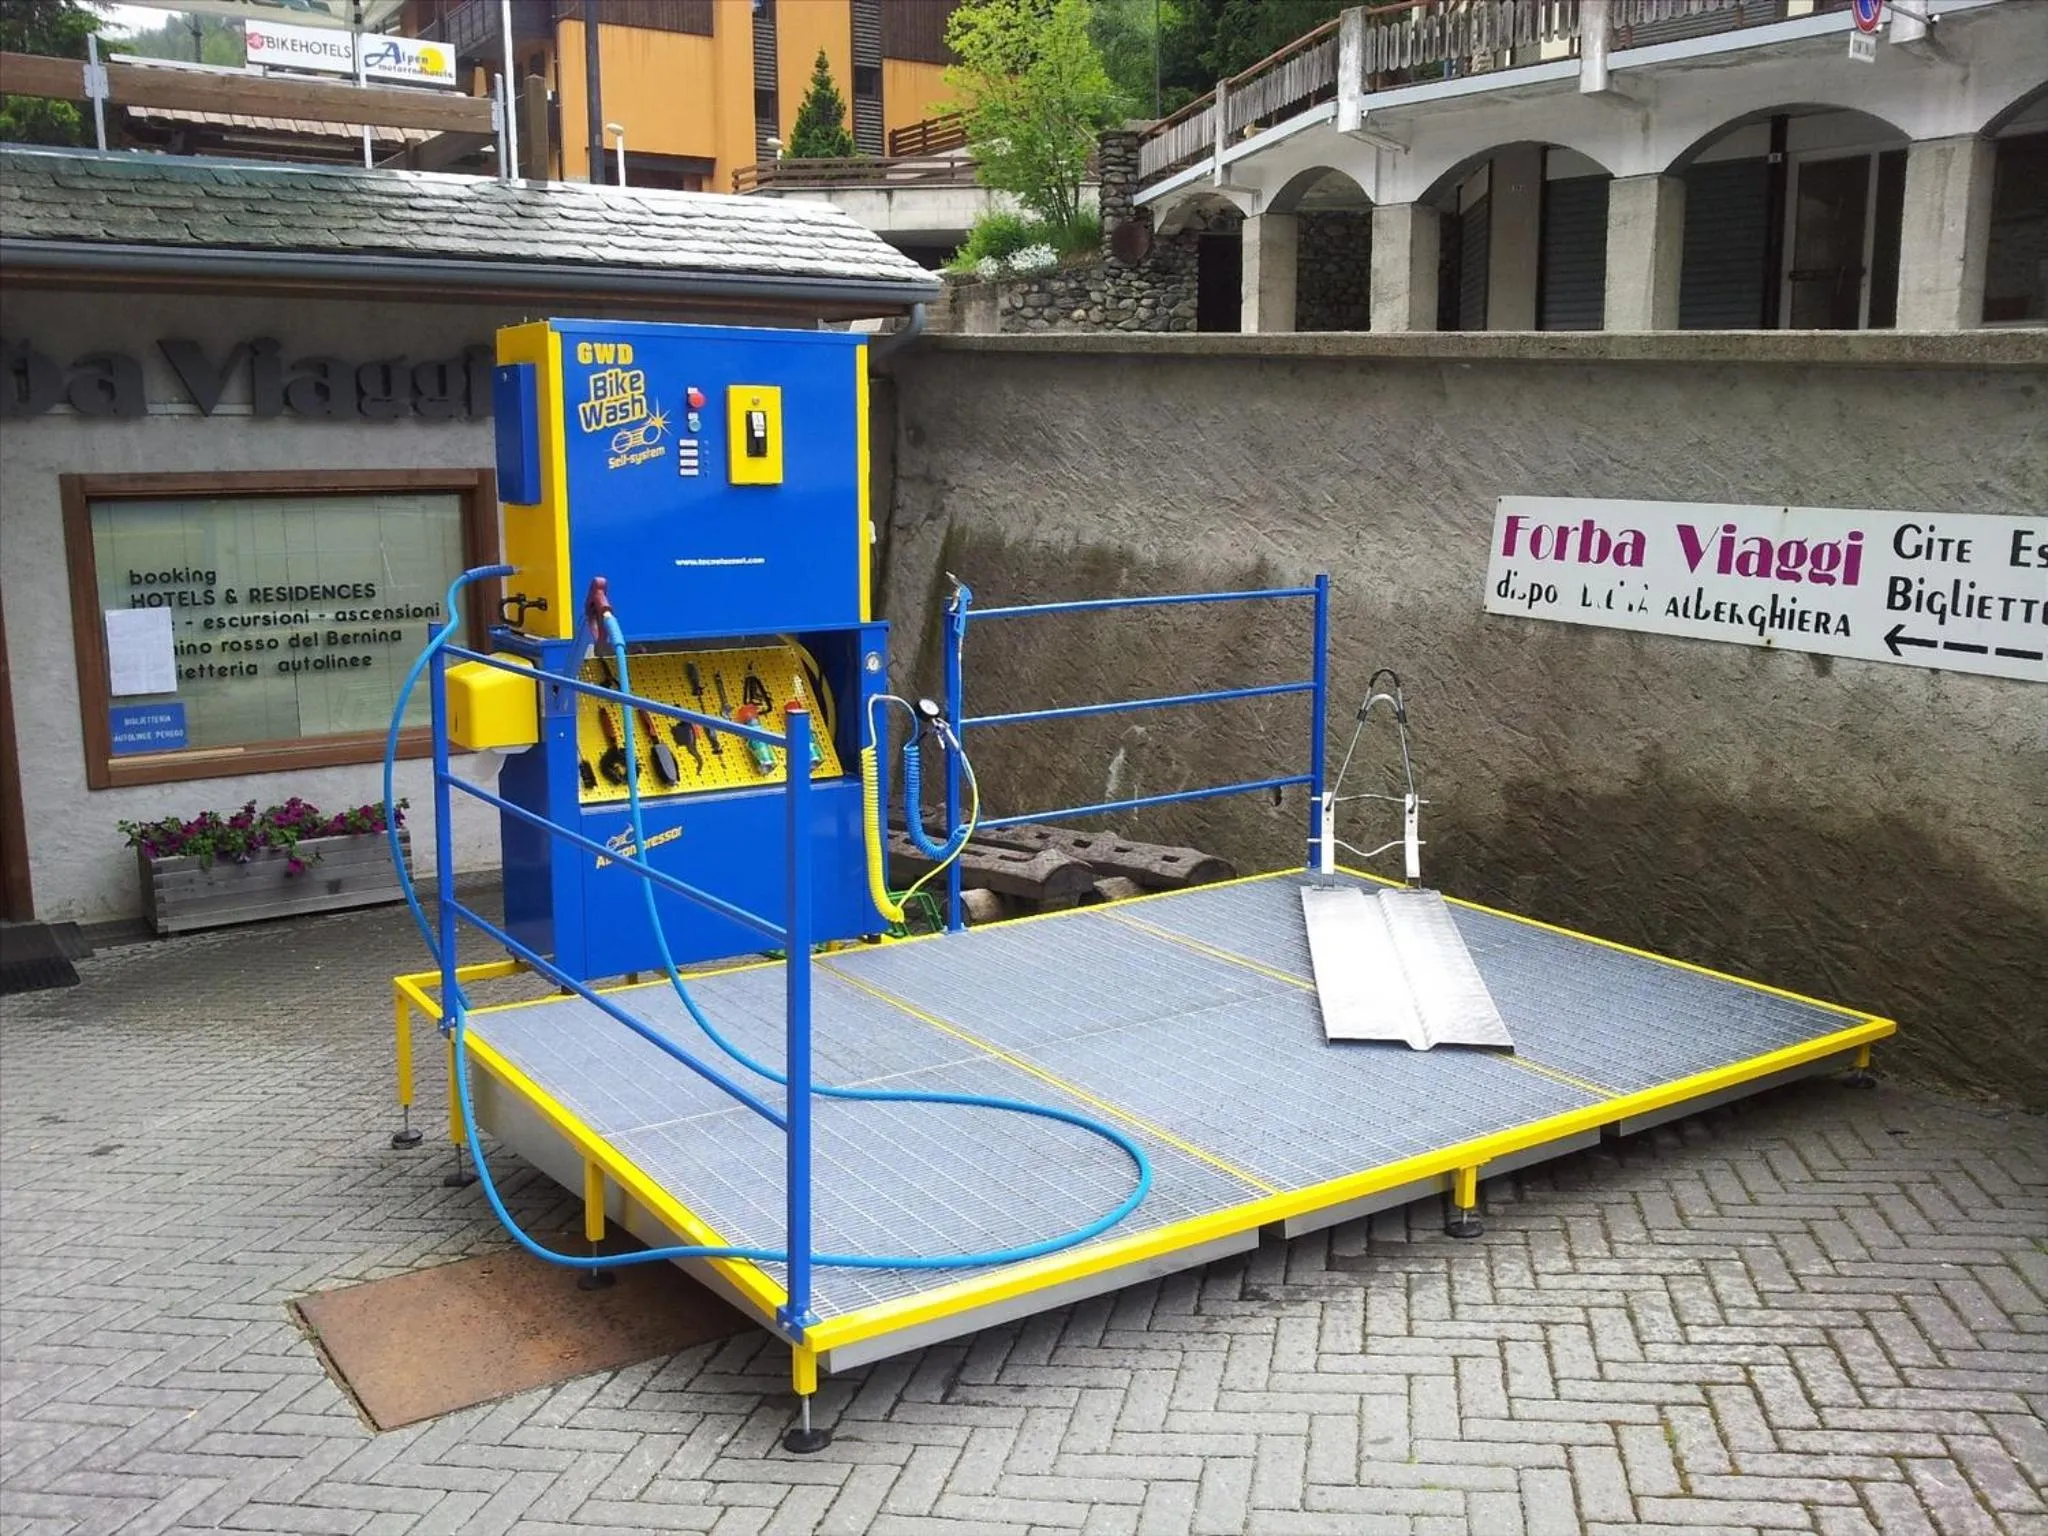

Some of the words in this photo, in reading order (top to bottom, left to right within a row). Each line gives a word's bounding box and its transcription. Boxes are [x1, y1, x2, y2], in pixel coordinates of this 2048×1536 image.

[267, 35, 352, 58] BIKEHOTELS
[364, 41, 429, 68] Alpen
[577, 342, 633, 364] GWD
[156, 336, 494, 419] Viaggi
[589, 368, 644, 401] Bike
[578, 394, 647, 432] Wash
[1502, 515, 1646, 568] Forba
[1676, 523, 1865, 586] Viaggi
[129, 567, 217, 586] booking
[131, 589, 216, 608] HOTELS
[225, 588, 238, 605] &
[249, 583, 377, 604] RESIDENCES
[203, 609, 310, 630] escursioni
[335, 602, 440, 622] ascensioni
[221, 637, 279, 653] rosso
[288, 631, 319, 649] del
[327, 628, 402, 646] Bernina
[178, 661, 258, 681] ietteria
[278, 654, 373, 673] autolinee
